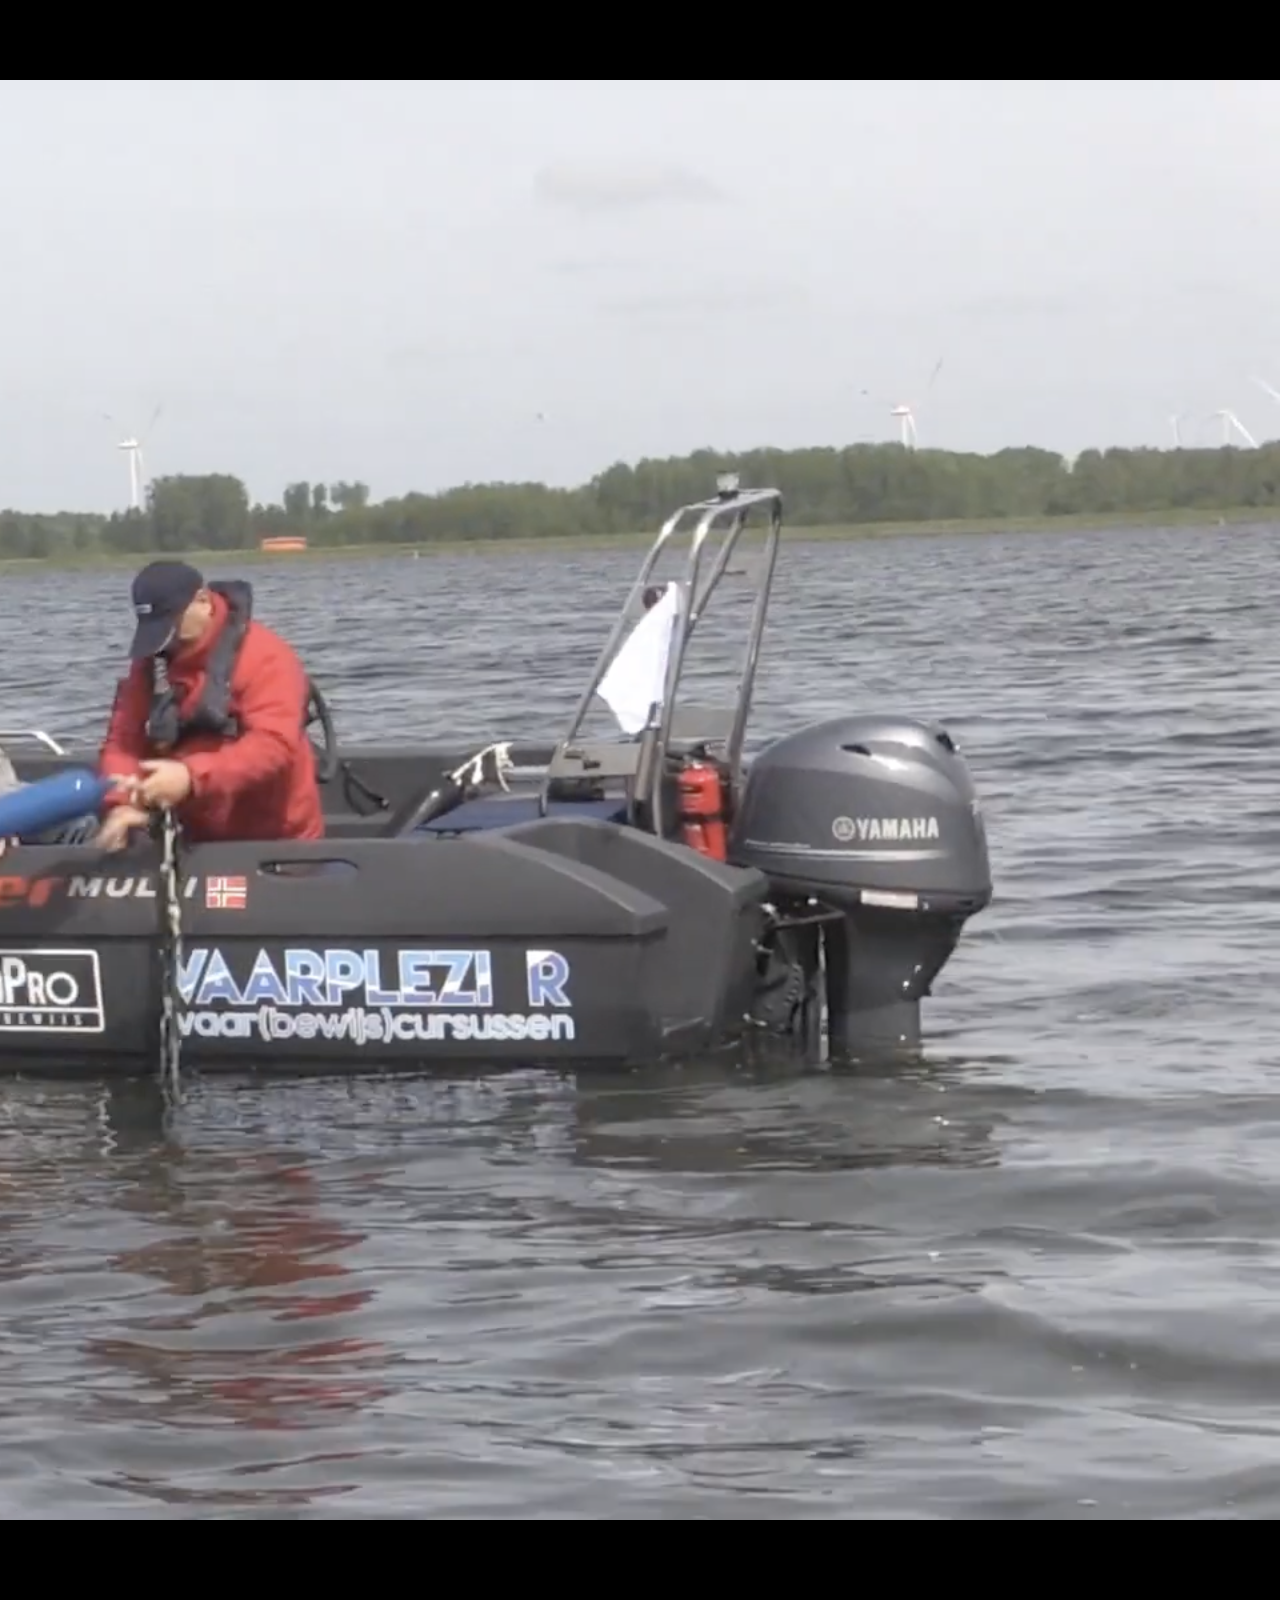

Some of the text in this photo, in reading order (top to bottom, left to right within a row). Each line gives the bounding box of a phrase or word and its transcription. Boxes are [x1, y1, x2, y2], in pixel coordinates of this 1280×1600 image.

[856, 816, 940, 840] YAMAHA
[66, 876, 199, 899] MULI
[176, 947, 572, 1007] VAARPLEZIR
[177, 1005, 575, 1044] vaar(bewijs)cursussen
